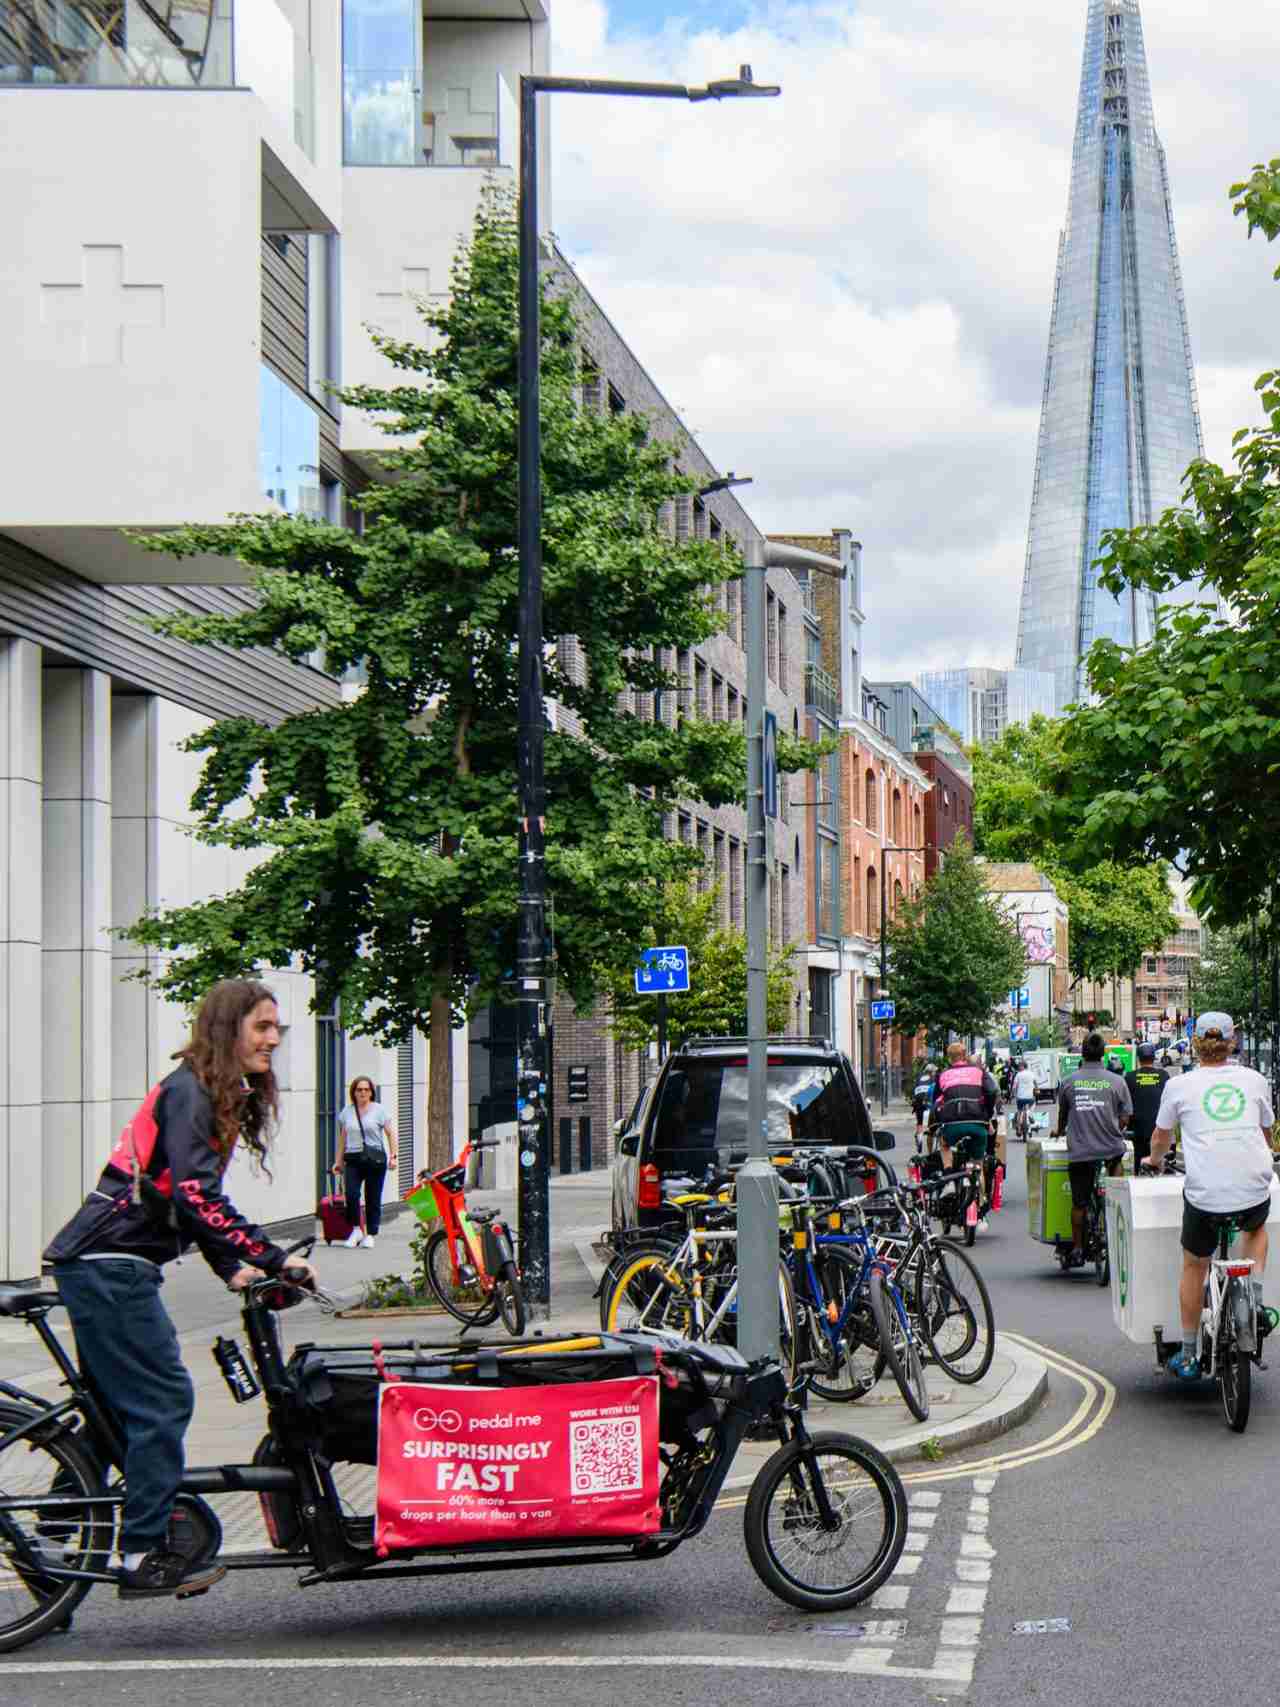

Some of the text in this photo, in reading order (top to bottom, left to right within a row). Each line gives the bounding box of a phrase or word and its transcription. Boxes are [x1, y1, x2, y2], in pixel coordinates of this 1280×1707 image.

[178, 1179, 265, 1257] pedal me
[469, 1413, 542, 1432] pedal me
[402, 1440, 552, 1460] SURPRISINGLY
[437, 1462, 520, 1492] FAST
[448, 1494, 505, 1506] 60% more
[400, 1509, 552, 1522] drops per hour than a van
